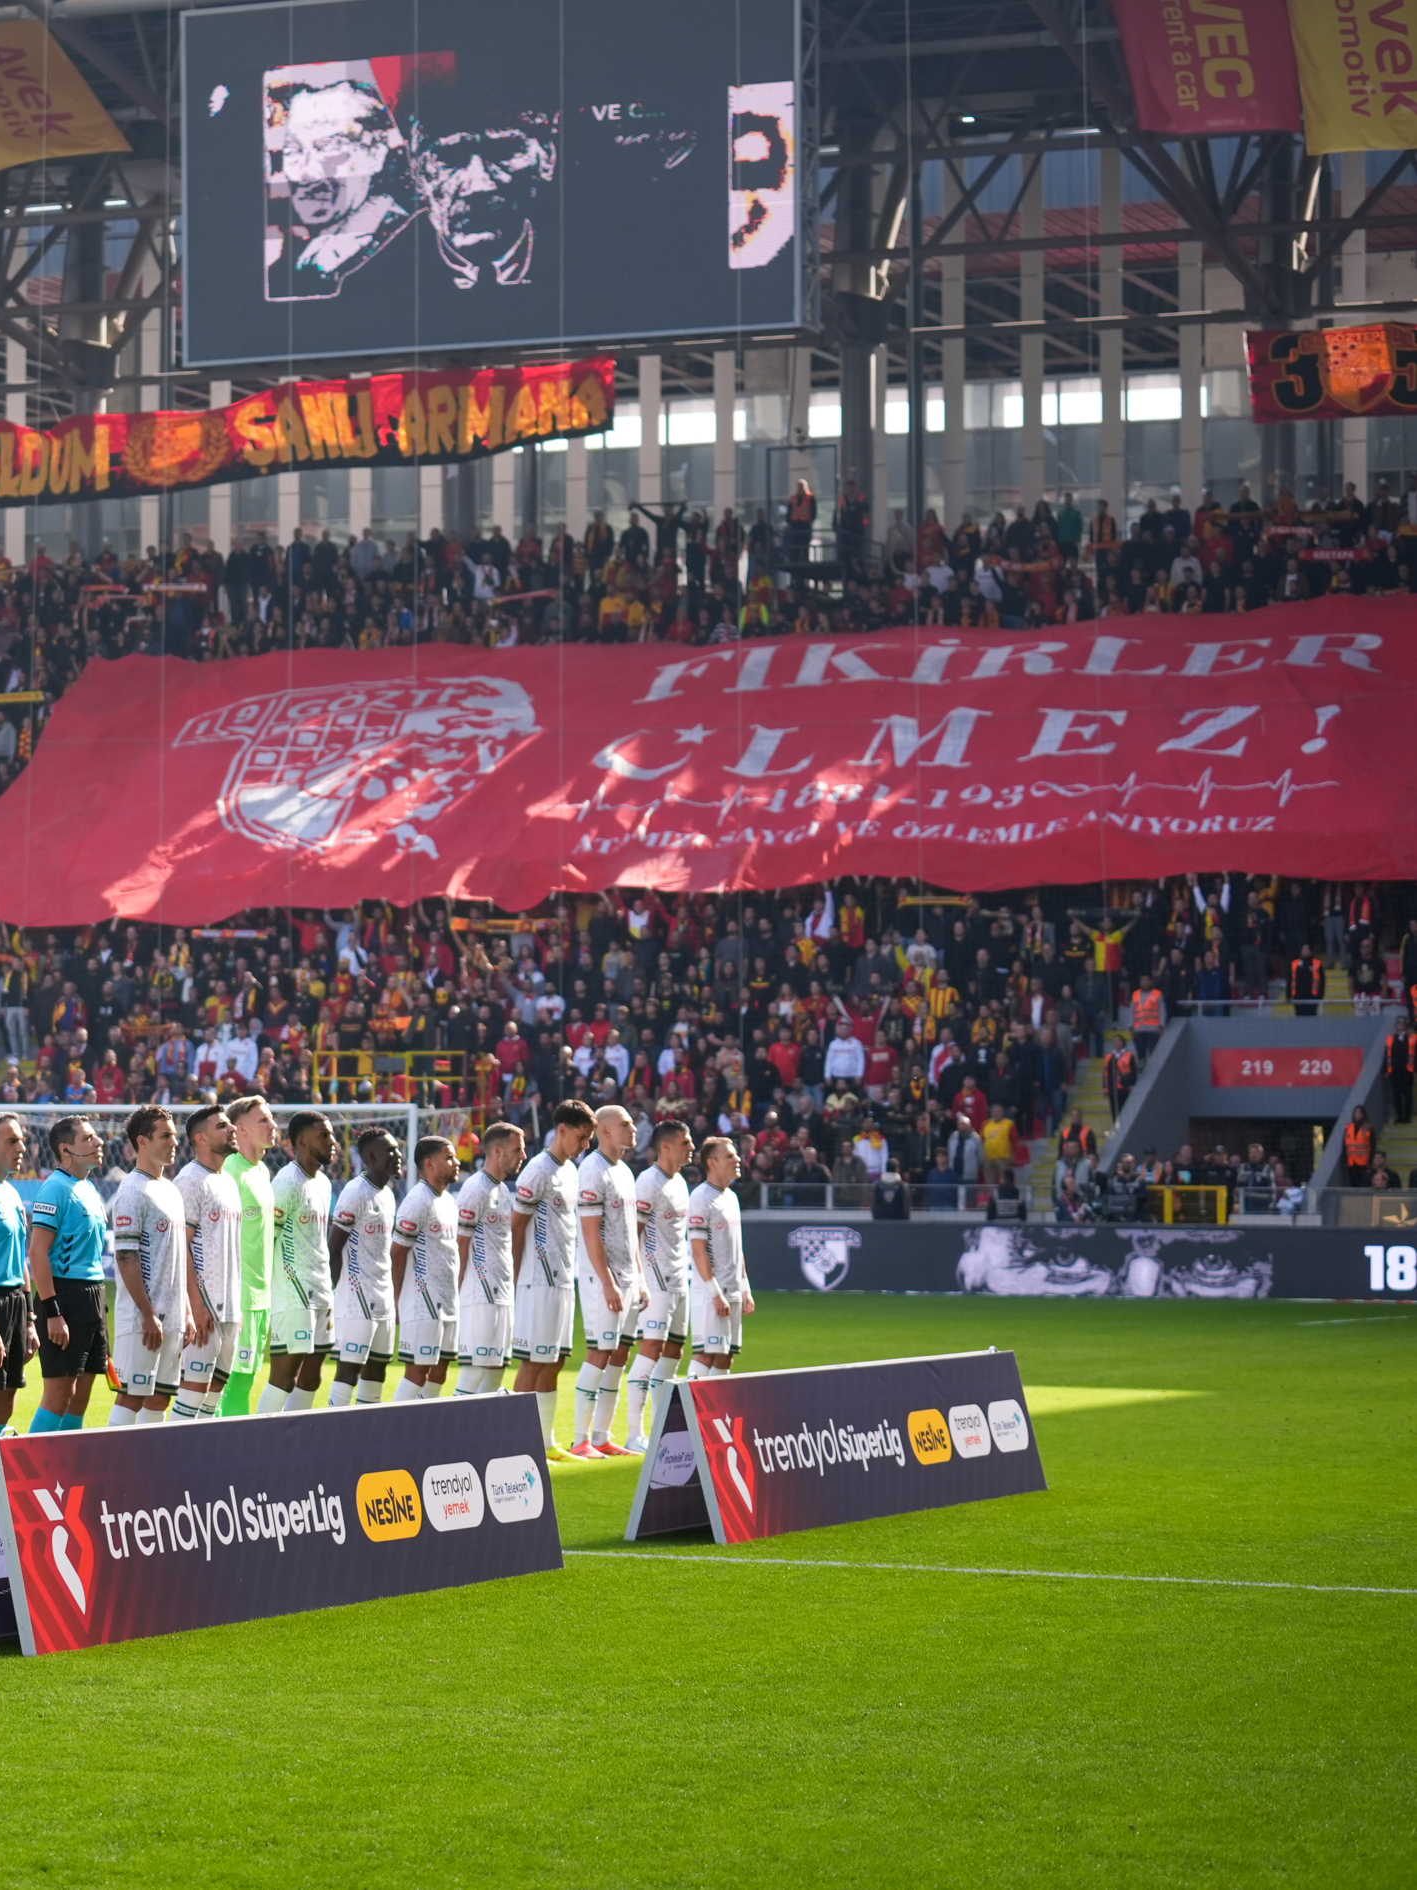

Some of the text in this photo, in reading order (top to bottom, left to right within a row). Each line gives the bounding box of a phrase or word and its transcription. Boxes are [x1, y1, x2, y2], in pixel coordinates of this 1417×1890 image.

[1172, 52, 1192, 66] a
[1175, 69, 1200, 112] car
[396, 374, 608, 458] ARMANA
[836, 819, 883, 838] VE
[892, 817, 1069, 845] ÖZLEMLE
[1241, 1059, 1333, 1076] 219 220
[283, 1233, 295, 1264] Rent
[415, 1247, 427, 1276] Rent
[954, 1412, 982, 1431] trendyol
[754, 1418, 905, 1476] trendyol süperLig
[431, 1472, 473, 1496] trendyol
[491, 1481, 528, 1496] Türk Telekom
[100, 1483, 346, 1562] trendyol süperLig
[443, 1498, 470, 1519] yemek
